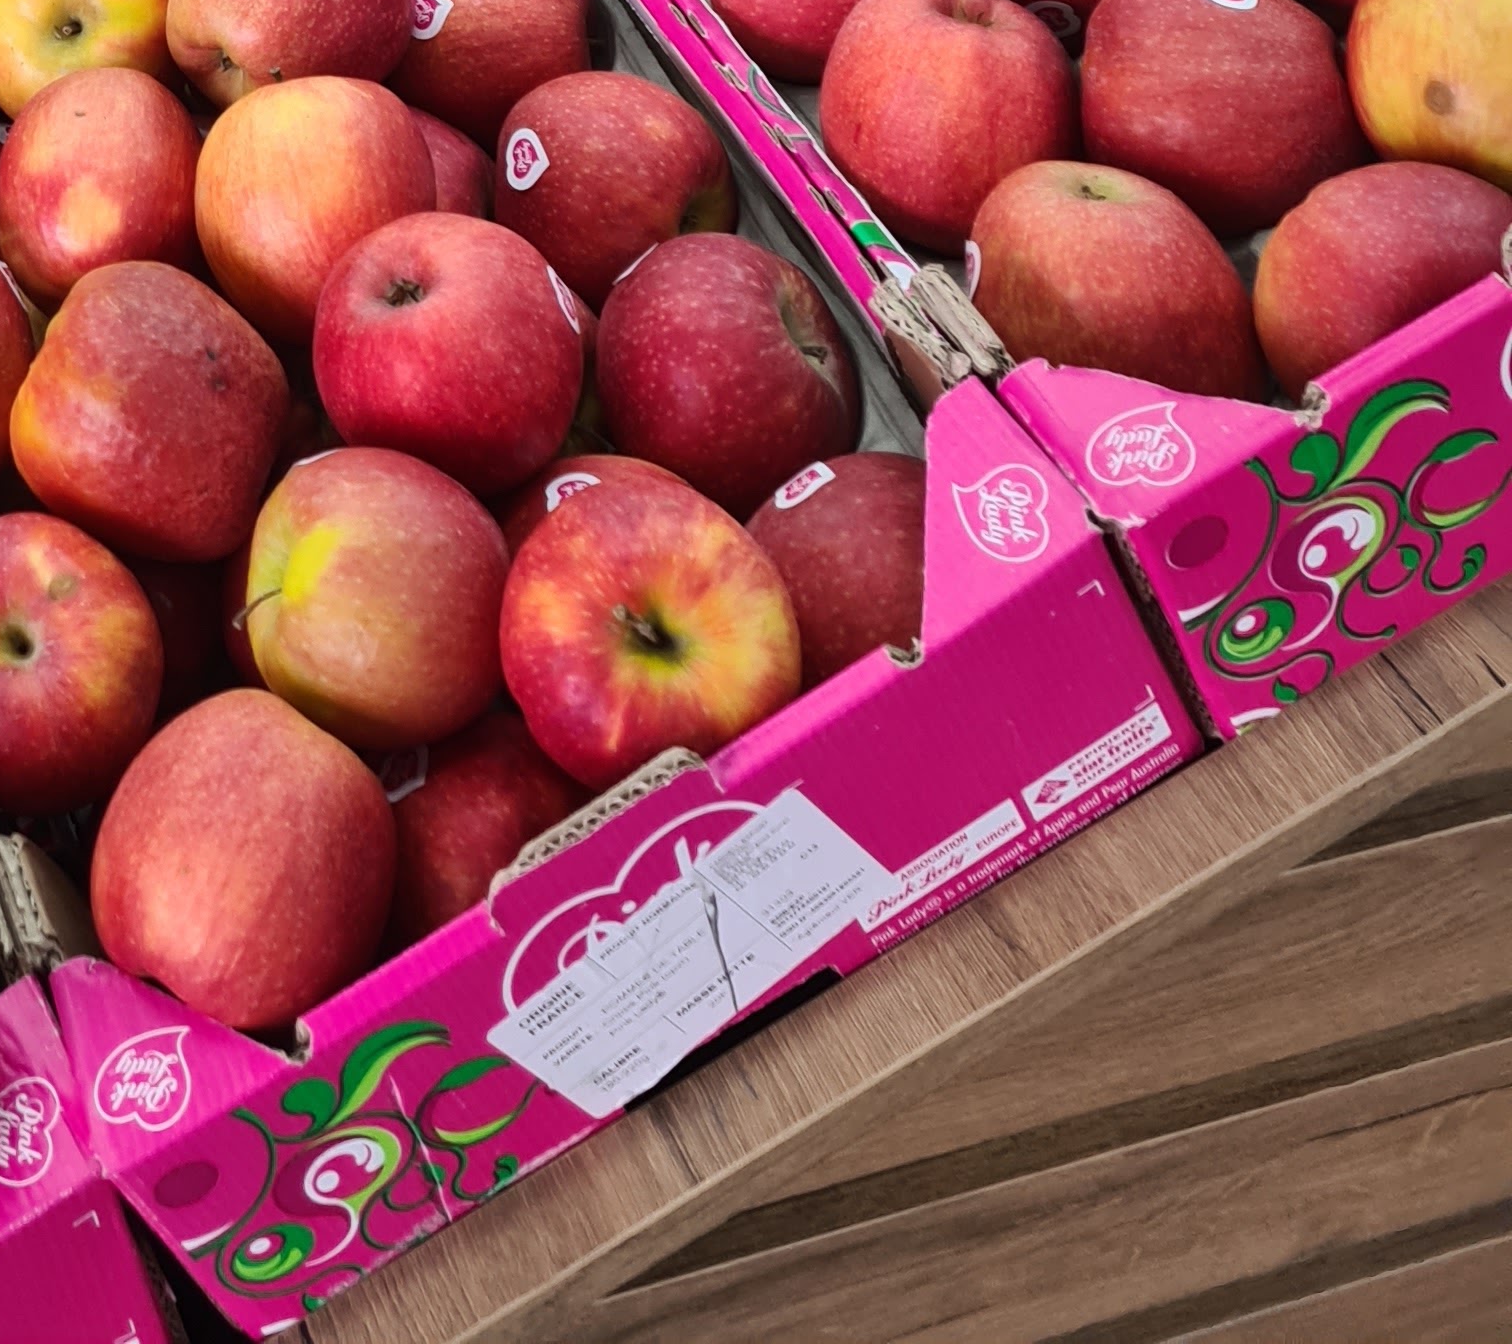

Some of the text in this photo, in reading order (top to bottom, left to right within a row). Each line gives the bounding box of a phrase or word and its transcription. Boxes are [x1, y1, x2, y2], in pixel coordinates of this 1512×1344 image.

[1105, 424, 1173, 450] Lady
[1107, 439, 1180, 476] Pink
[978, 485, 1008, 547] Lady
[998, 476, 1037, 543] Pink
[871, 926, 898, 947] Pink
[942, 886, 956, 900] is
[964, 838, 1029, 885] trademark
[1025, 828, 1043, 846] of
[1040, 808, 1081, 843] Apple
[1074, 791, 1102, 814] and
[1100, 775, 1130, 799] Pear
[1126, 741, 1181, 780] Australia
[896, 832, 970, 881] ASSOCIATION
[867, 882, 915, 924] Pink
[974, 818, 1020, 850] EUROPE
[515, 979, 578, 1030] ORIGINE
[526, 987, 587, 1037] FRANCE
[116, 1047, 177, 1079] Lady
[111, 1076, 178, 1113] Pink
[14, 1092, 43, 1165] Pink
